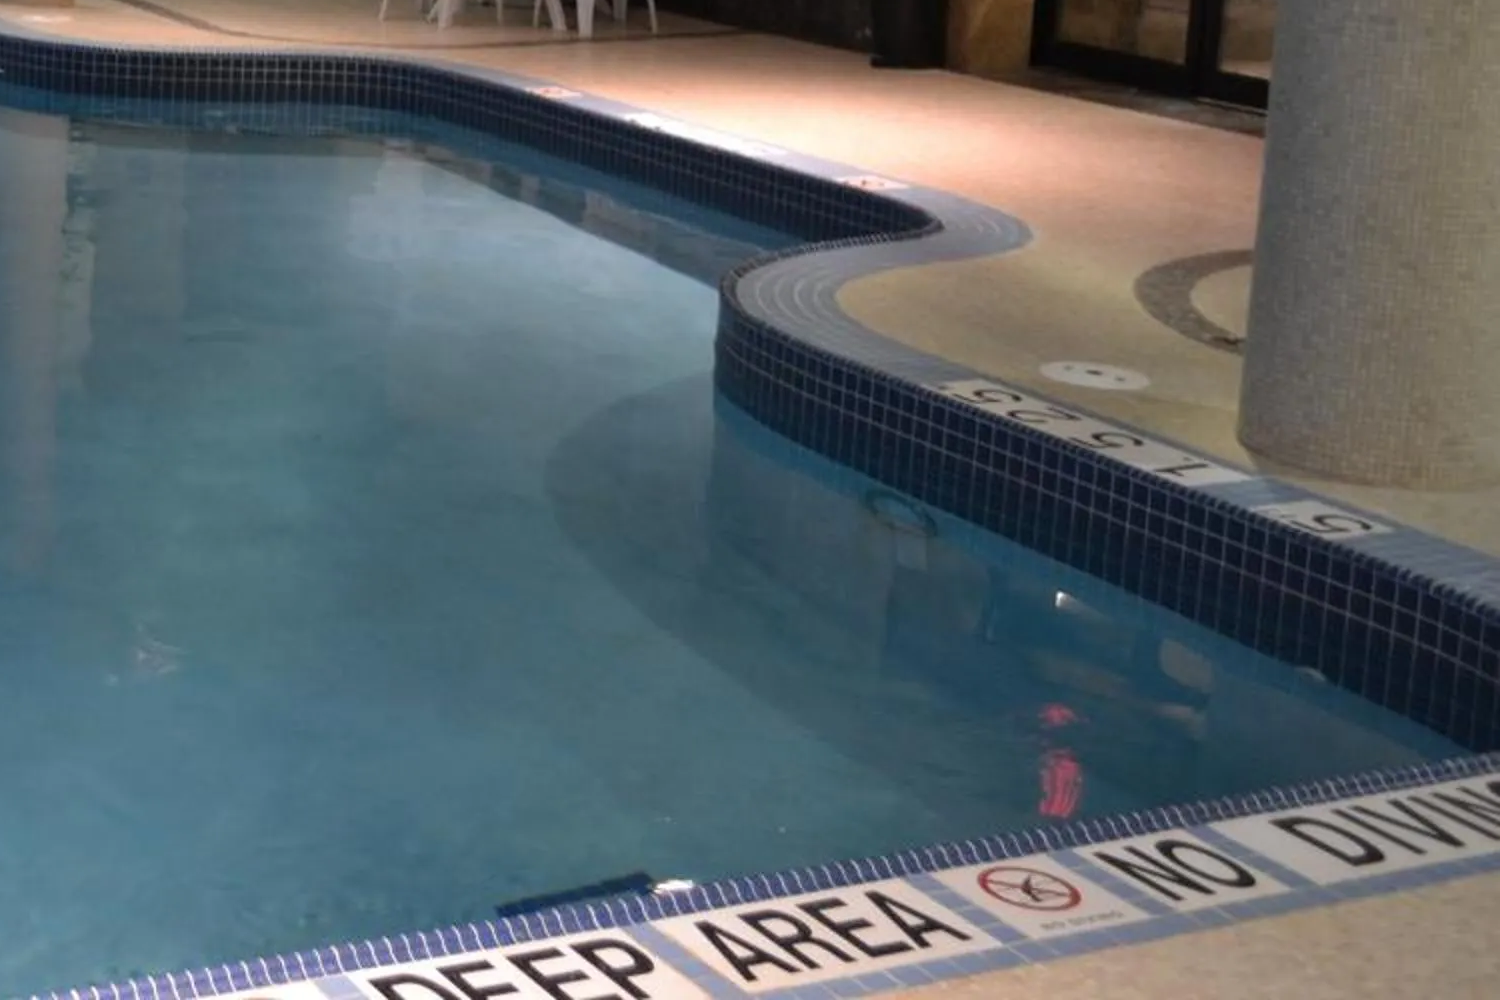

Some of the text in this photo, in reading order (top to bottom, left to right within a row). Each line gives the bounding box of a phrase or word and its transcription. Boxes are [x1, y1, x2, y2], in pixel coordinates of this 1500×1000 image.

[1093, 779, 1500, 902] NO DIVIN
[693, 890, 973, 982] AREA
